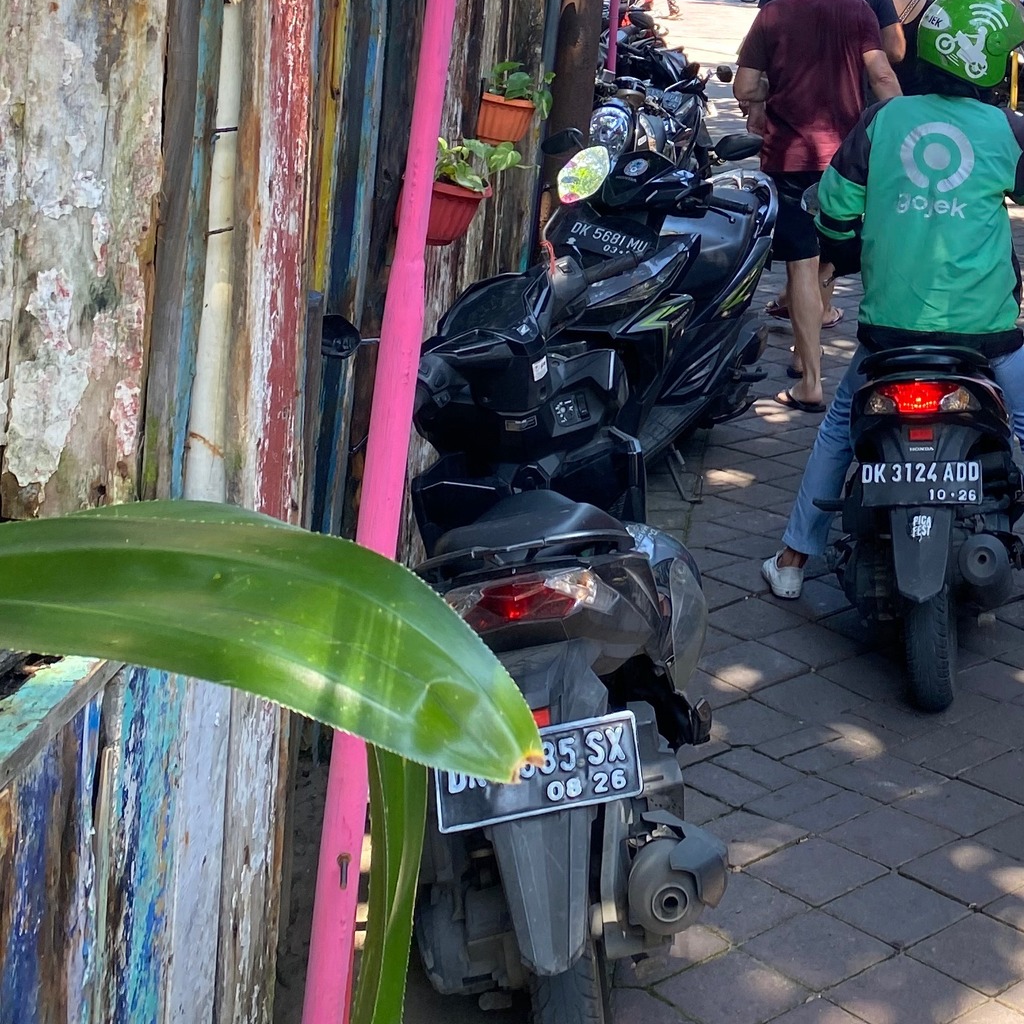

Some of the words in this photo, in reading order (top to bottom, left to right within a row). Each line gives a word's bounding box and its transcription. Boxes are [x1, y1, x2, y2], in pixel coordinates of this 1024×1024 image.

[895, 193, 968, 219] gojek
[571, 221, 591, 236] DK
[592, 227, 626, 246] 5681
[626, 237, 649, 252] MU
[861, 463, 886, 484] DK
[891, 462, 938, 483] 3124
[943, 462, 980, 483] ADD
[912, 525, 931, 538] FEST
[584, 726, 626, 766] SX
[546, 777, 583, 802] 08
[593, 768, 628, 794] 26
